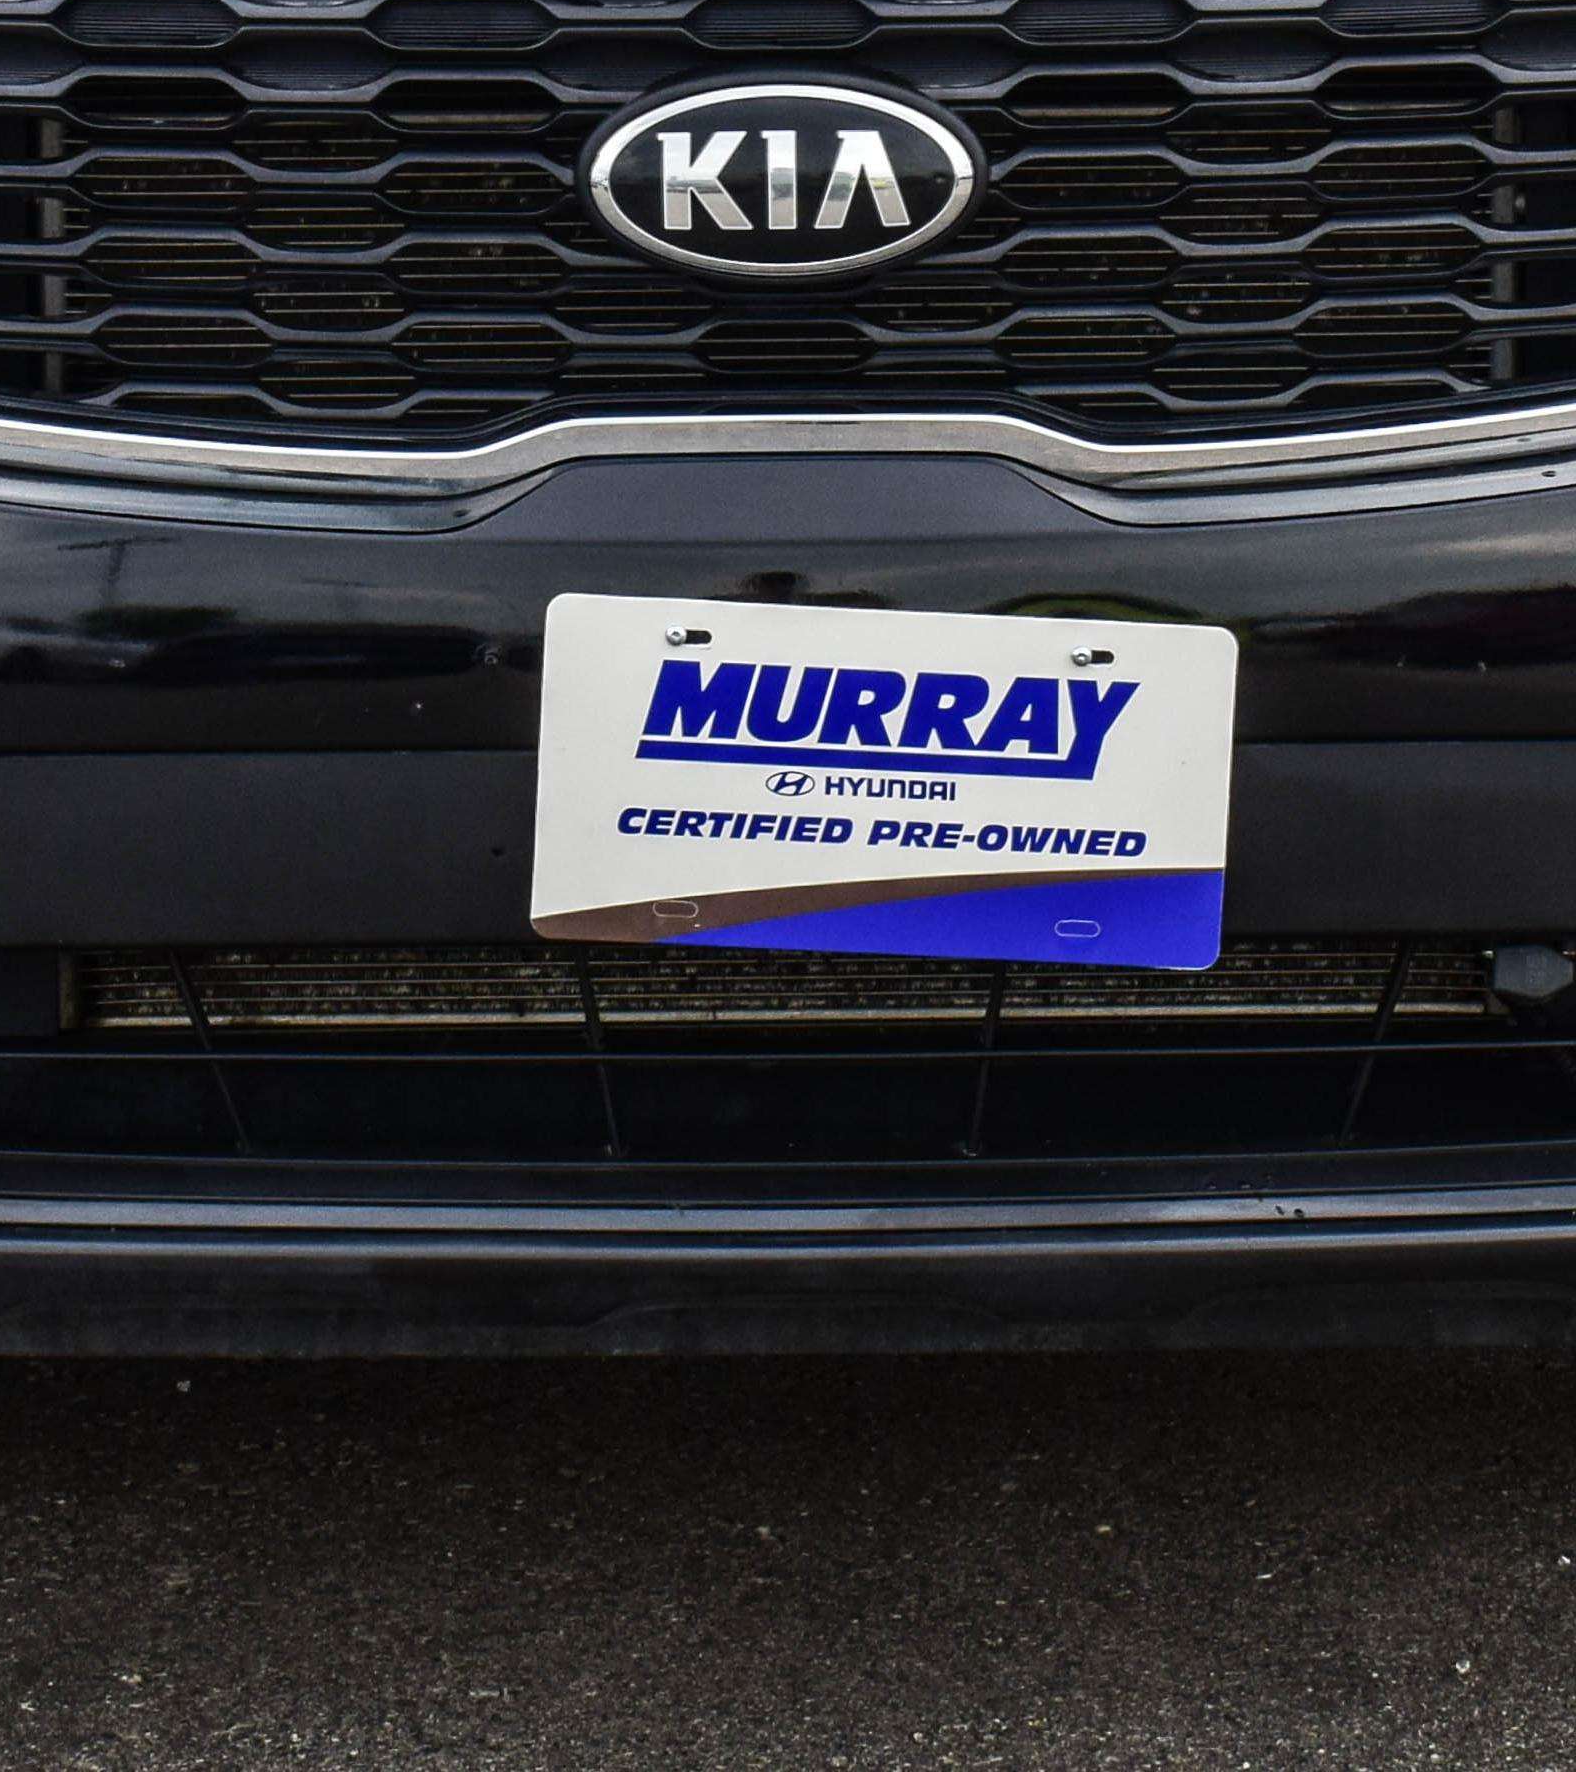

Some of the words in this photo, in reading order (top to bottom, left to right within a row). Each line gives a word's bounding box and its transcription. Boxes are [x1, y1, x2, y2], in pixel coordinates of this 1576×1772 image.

[657, 130, 911, 230] KIA
[640, 659, 1140, 780] MURRAY
[825, 775, 957, 802] HYUNDAI
[617, 807, 854, 844] CERTIFIED
[867, 820, 1147, 857] PRE-OWNED
